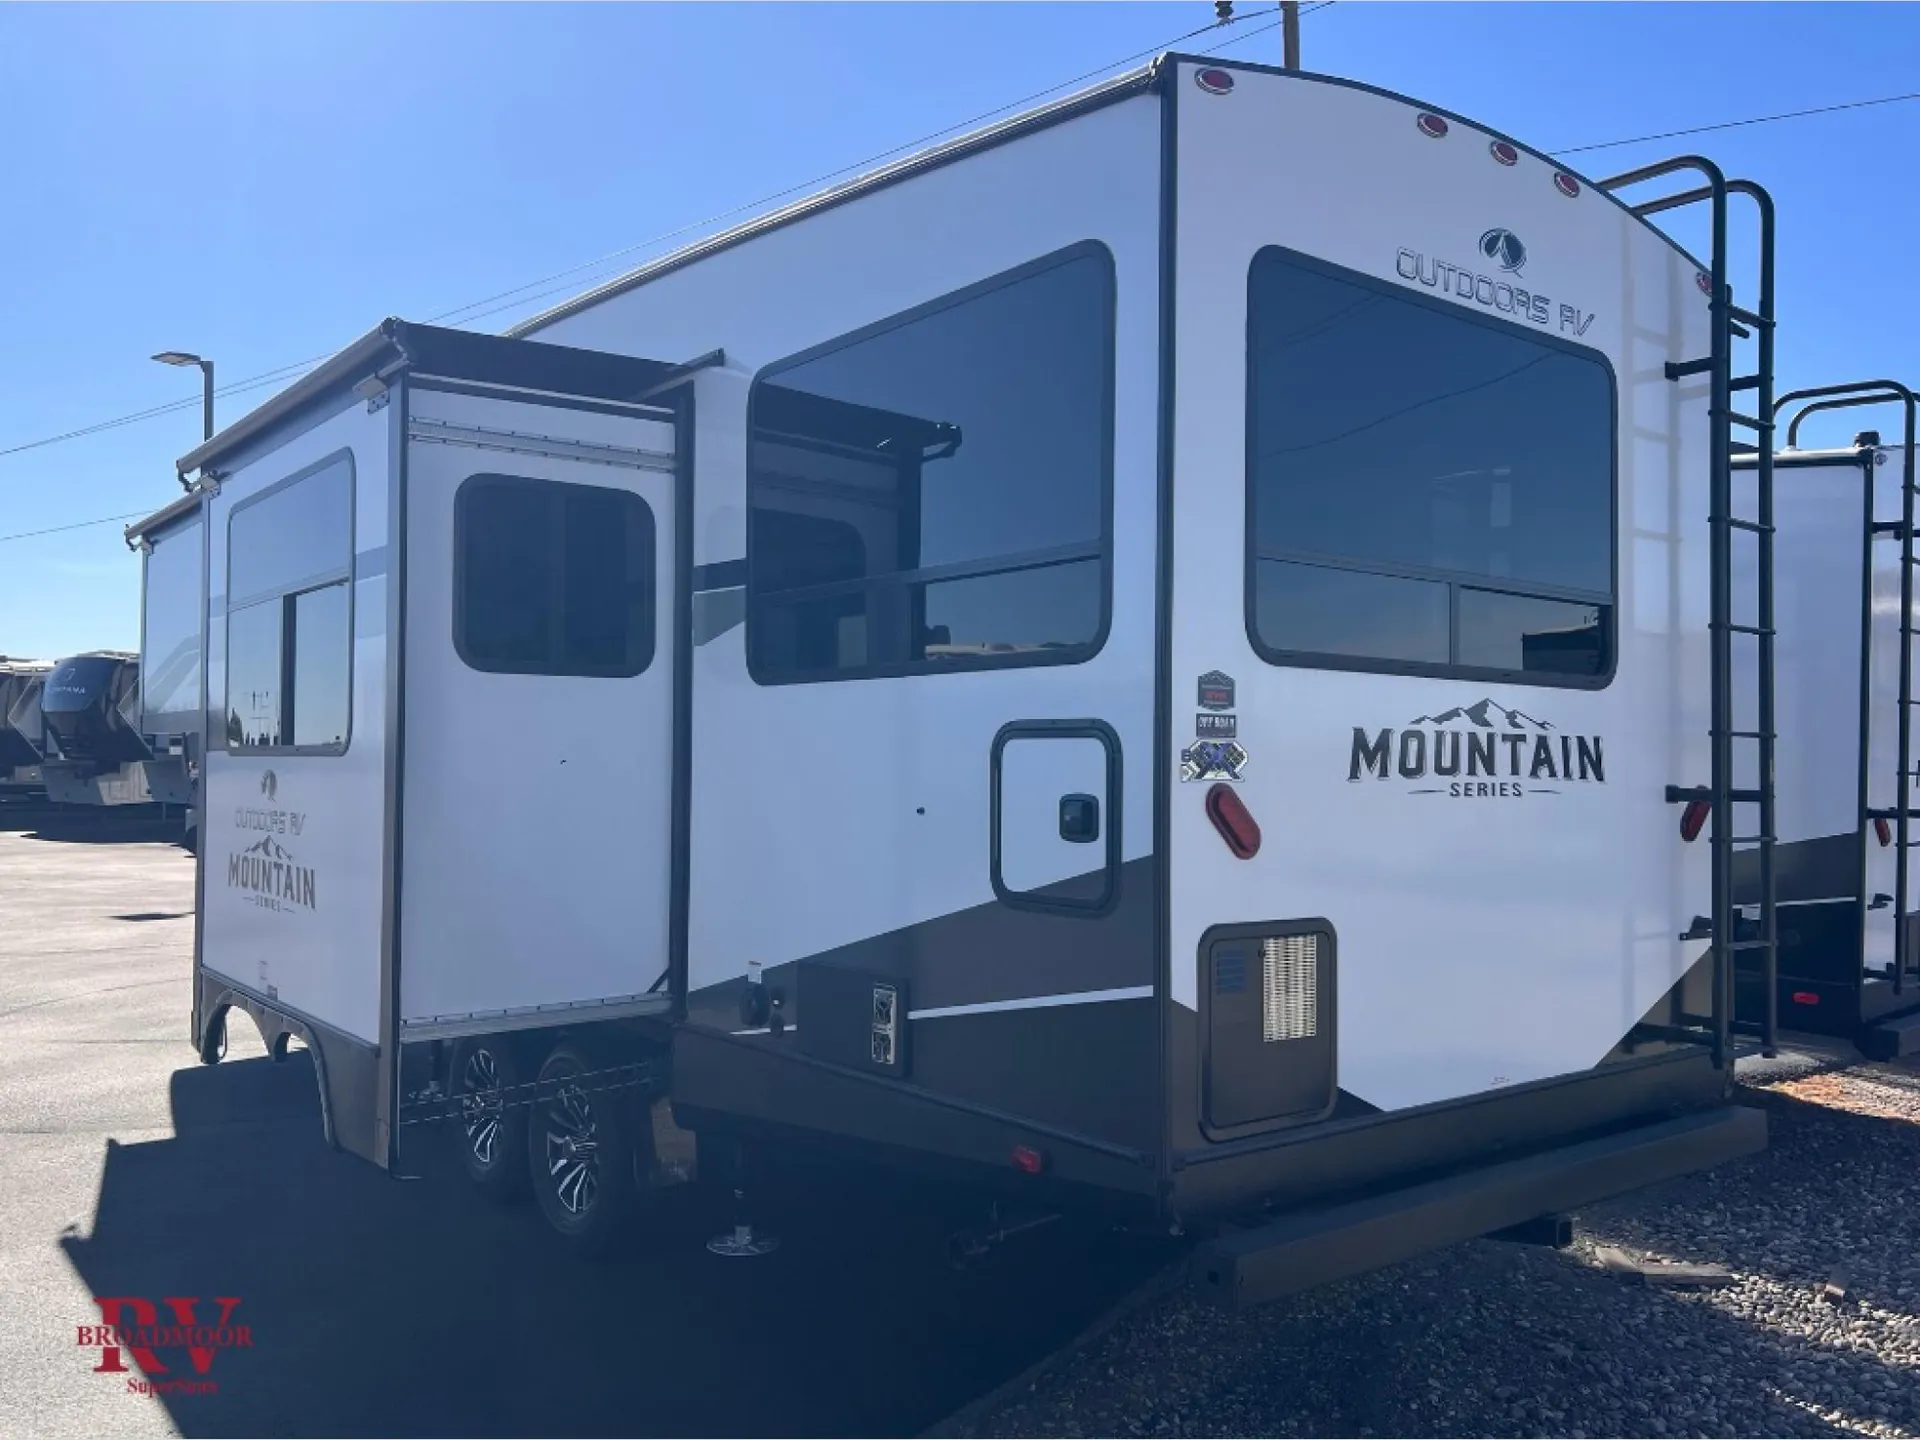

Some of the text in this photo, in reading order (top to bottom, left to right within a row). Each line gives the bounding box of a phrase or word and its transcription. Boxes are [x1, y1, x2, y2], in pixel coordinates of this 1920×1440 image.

[1396, 246, 1596, 337] OUTDOORS RV
[1348, 727, 1607, 783] MOUNTAIN
[1449, 782, 1523, 798] SERIES
[228, 851, 317, 911] MOUNTAIN
